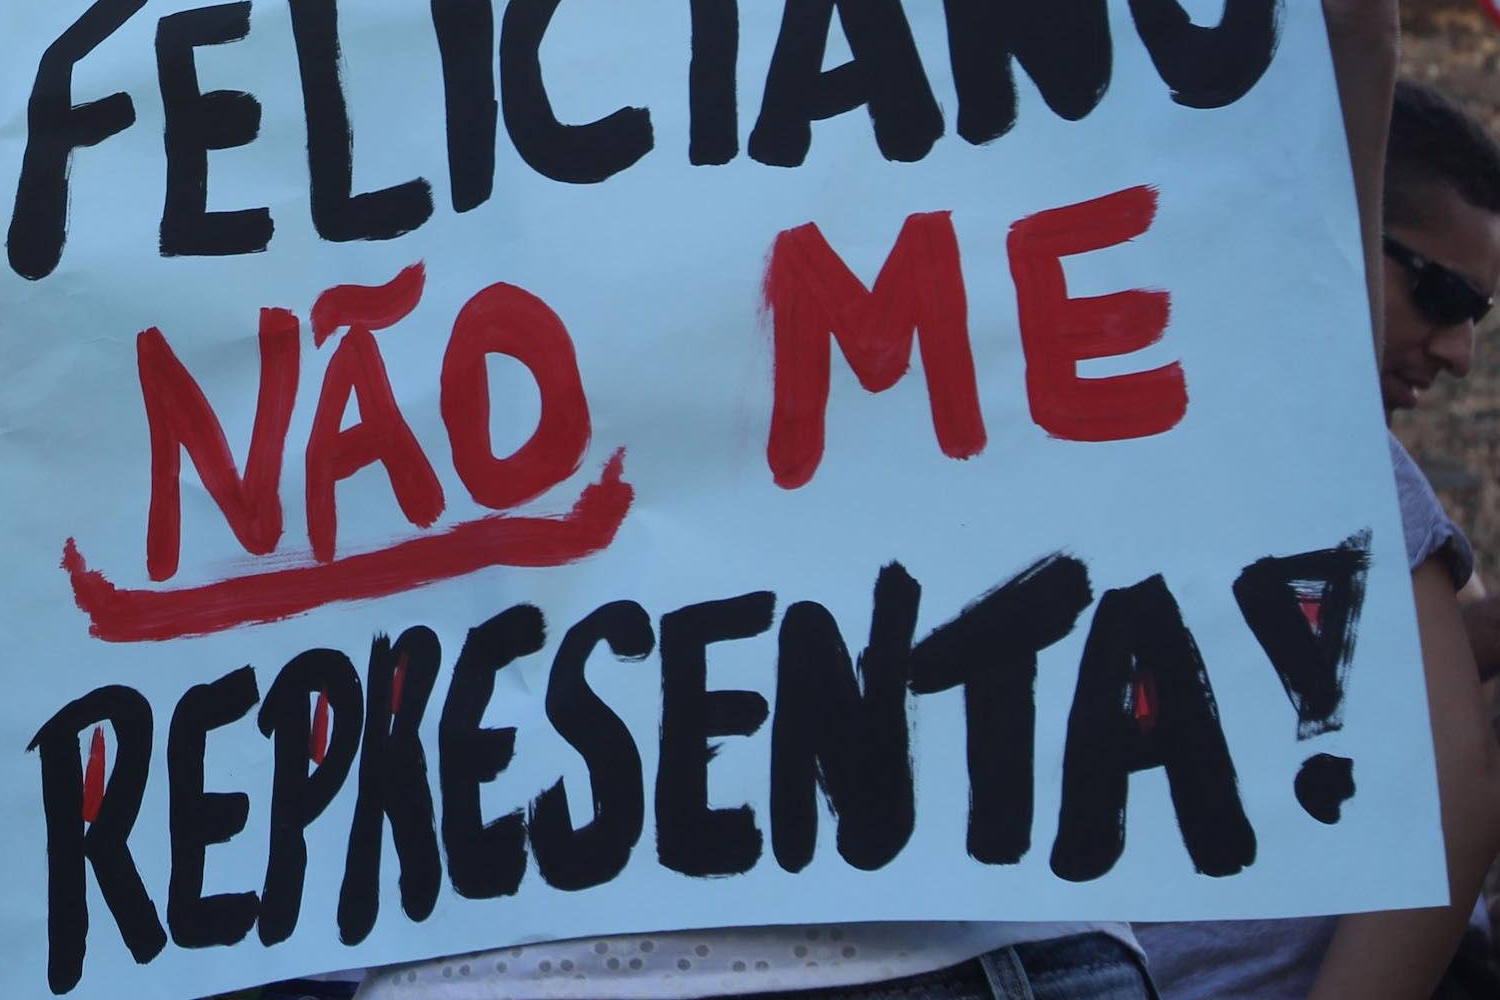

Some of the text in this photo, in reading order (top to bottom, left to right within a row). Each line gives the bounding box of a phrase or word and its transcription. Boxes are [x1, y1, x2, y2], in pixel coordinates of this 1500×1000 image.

[136, 184, 1190, 582] NÃO ME
[27, 529, 1372, 995] REPRESENTA!
